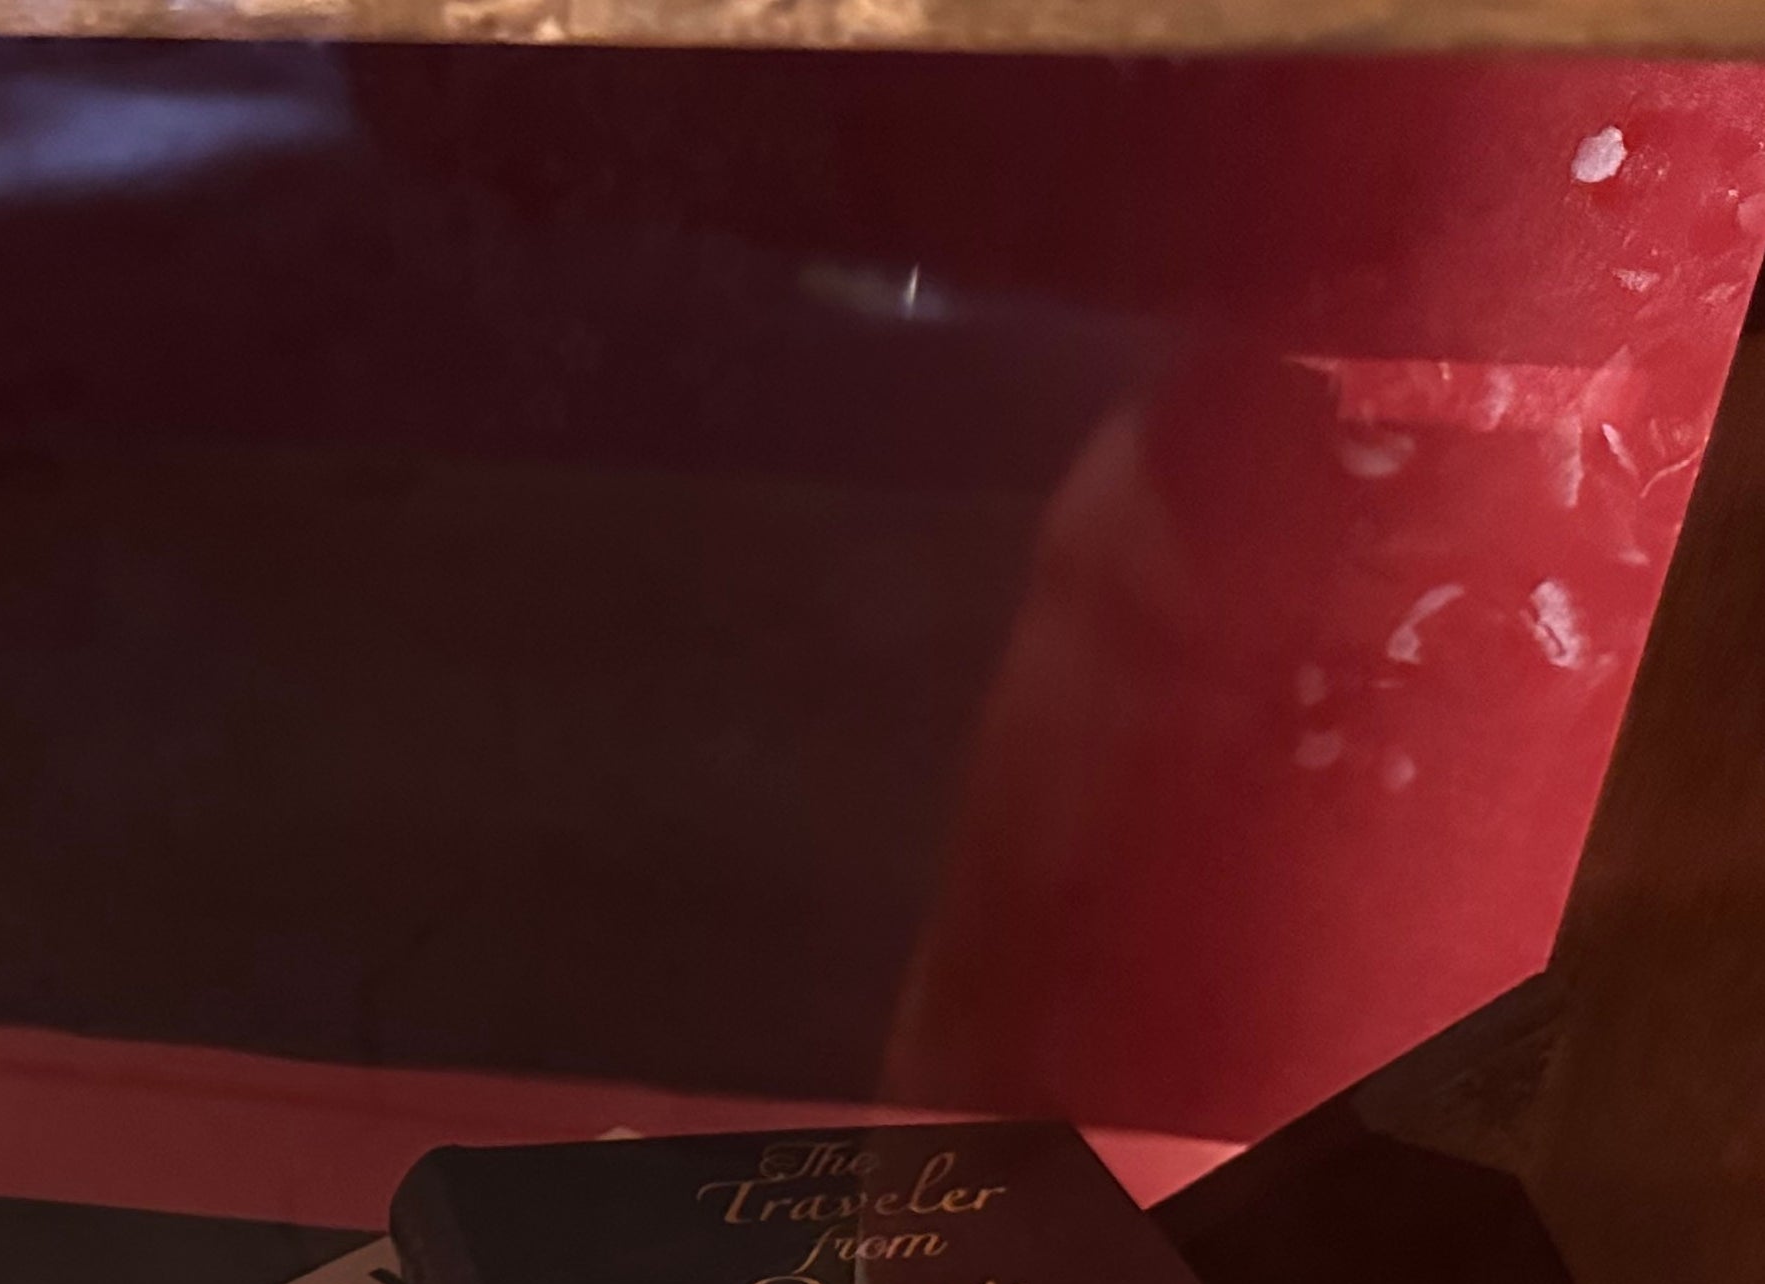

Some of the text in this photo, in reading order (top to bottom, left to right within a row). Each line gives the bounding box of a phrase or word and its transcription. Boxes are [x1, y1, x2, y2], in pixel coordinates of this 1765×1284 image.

[758, 1139, 881, 1181] The
[695, 1151, 1009, 1225] Traveler
[791, 1224, 949, 1276] from
